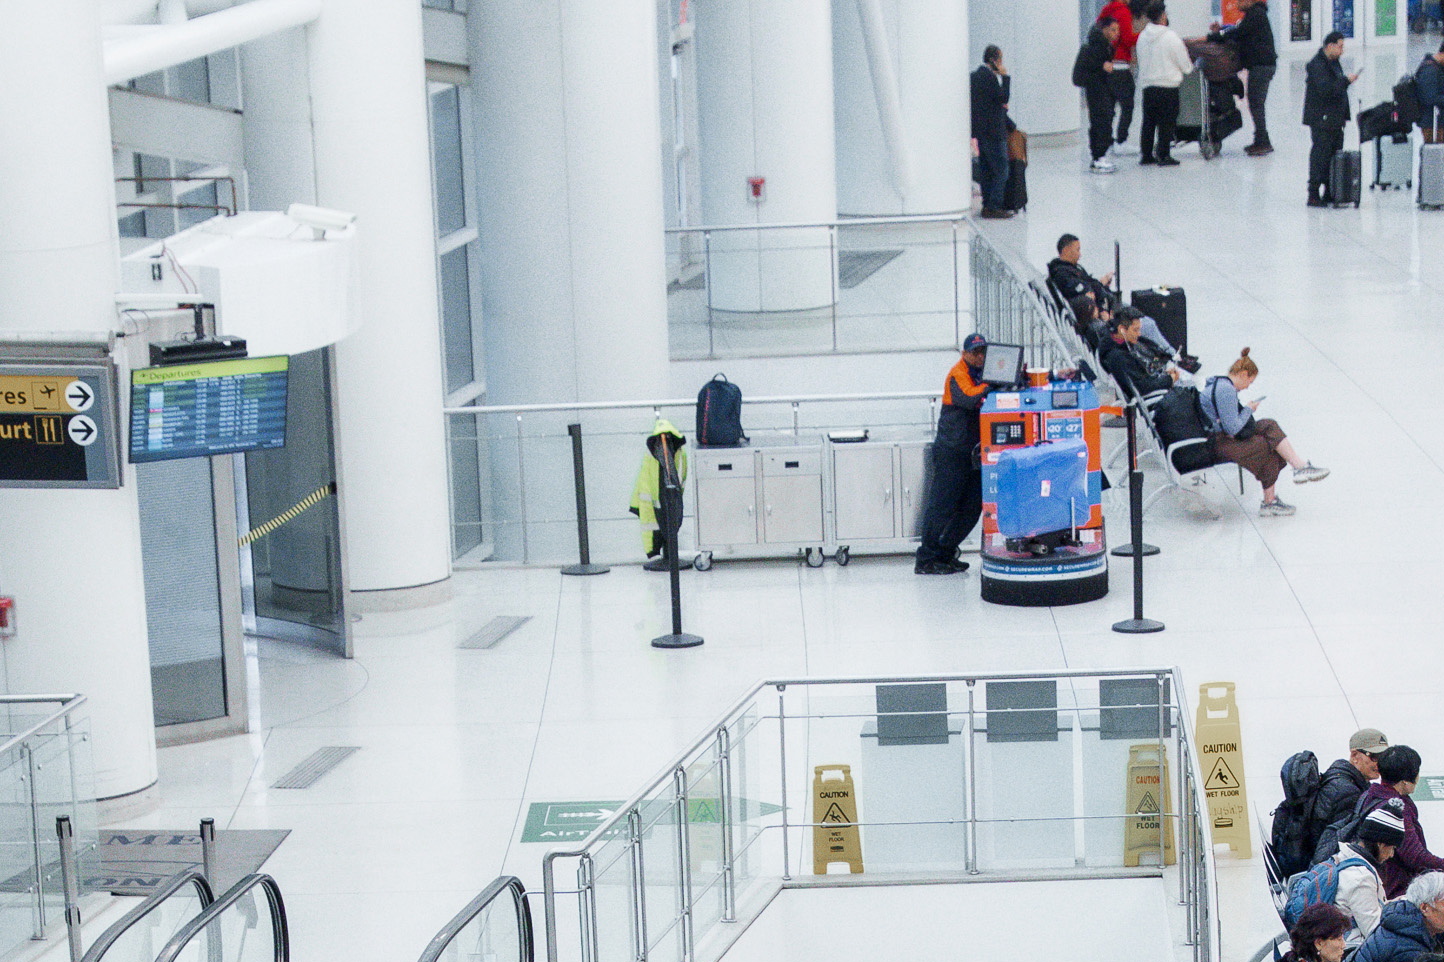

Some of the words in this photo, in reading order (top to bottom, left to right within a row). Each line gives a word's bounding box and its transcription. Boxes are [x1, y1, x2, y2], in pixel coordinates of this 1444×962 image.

[1203, 743, 1237, 754] CAUTION
[819, 791, 849, 799] CAUTION
[1220, 789, 1240, 798] FLOOR
